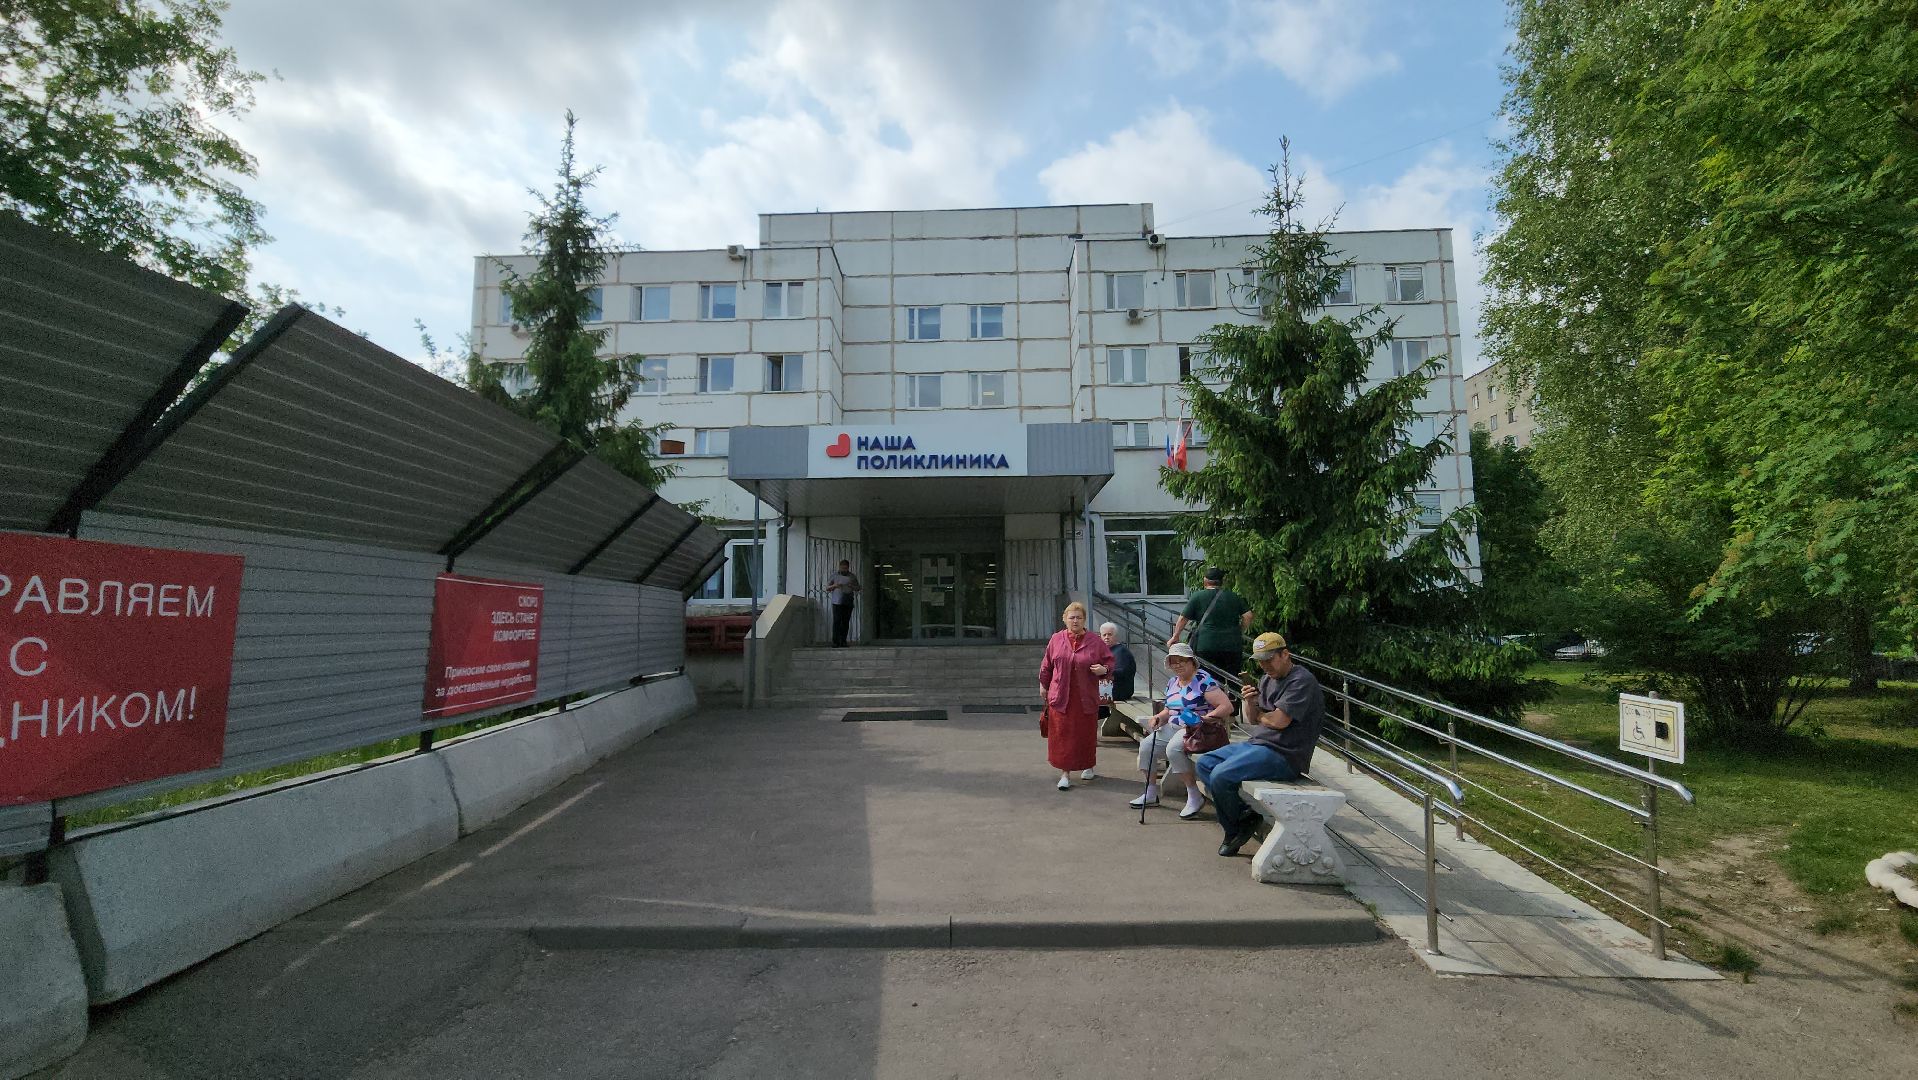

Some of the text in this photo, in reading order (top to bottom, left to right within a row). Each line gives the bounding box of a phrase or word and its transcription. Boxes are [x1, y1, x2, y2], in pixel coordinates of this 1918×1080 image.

[856, 435, 916, 451] НАША
[856, 453, 1010, 470] ПОЛИКЛИНИКА
[491, 611, 537, 625] ЗДЕСЬ СТАНЕТ
[493, 629, 536, 642] КОМФОРТНЕЕ
[9, 636, 48, 676] С
[445, 666, 485, 679] Приносим
[435, 687, 446, 697] за
[0, 686, 197, 749] НИКОМ!
